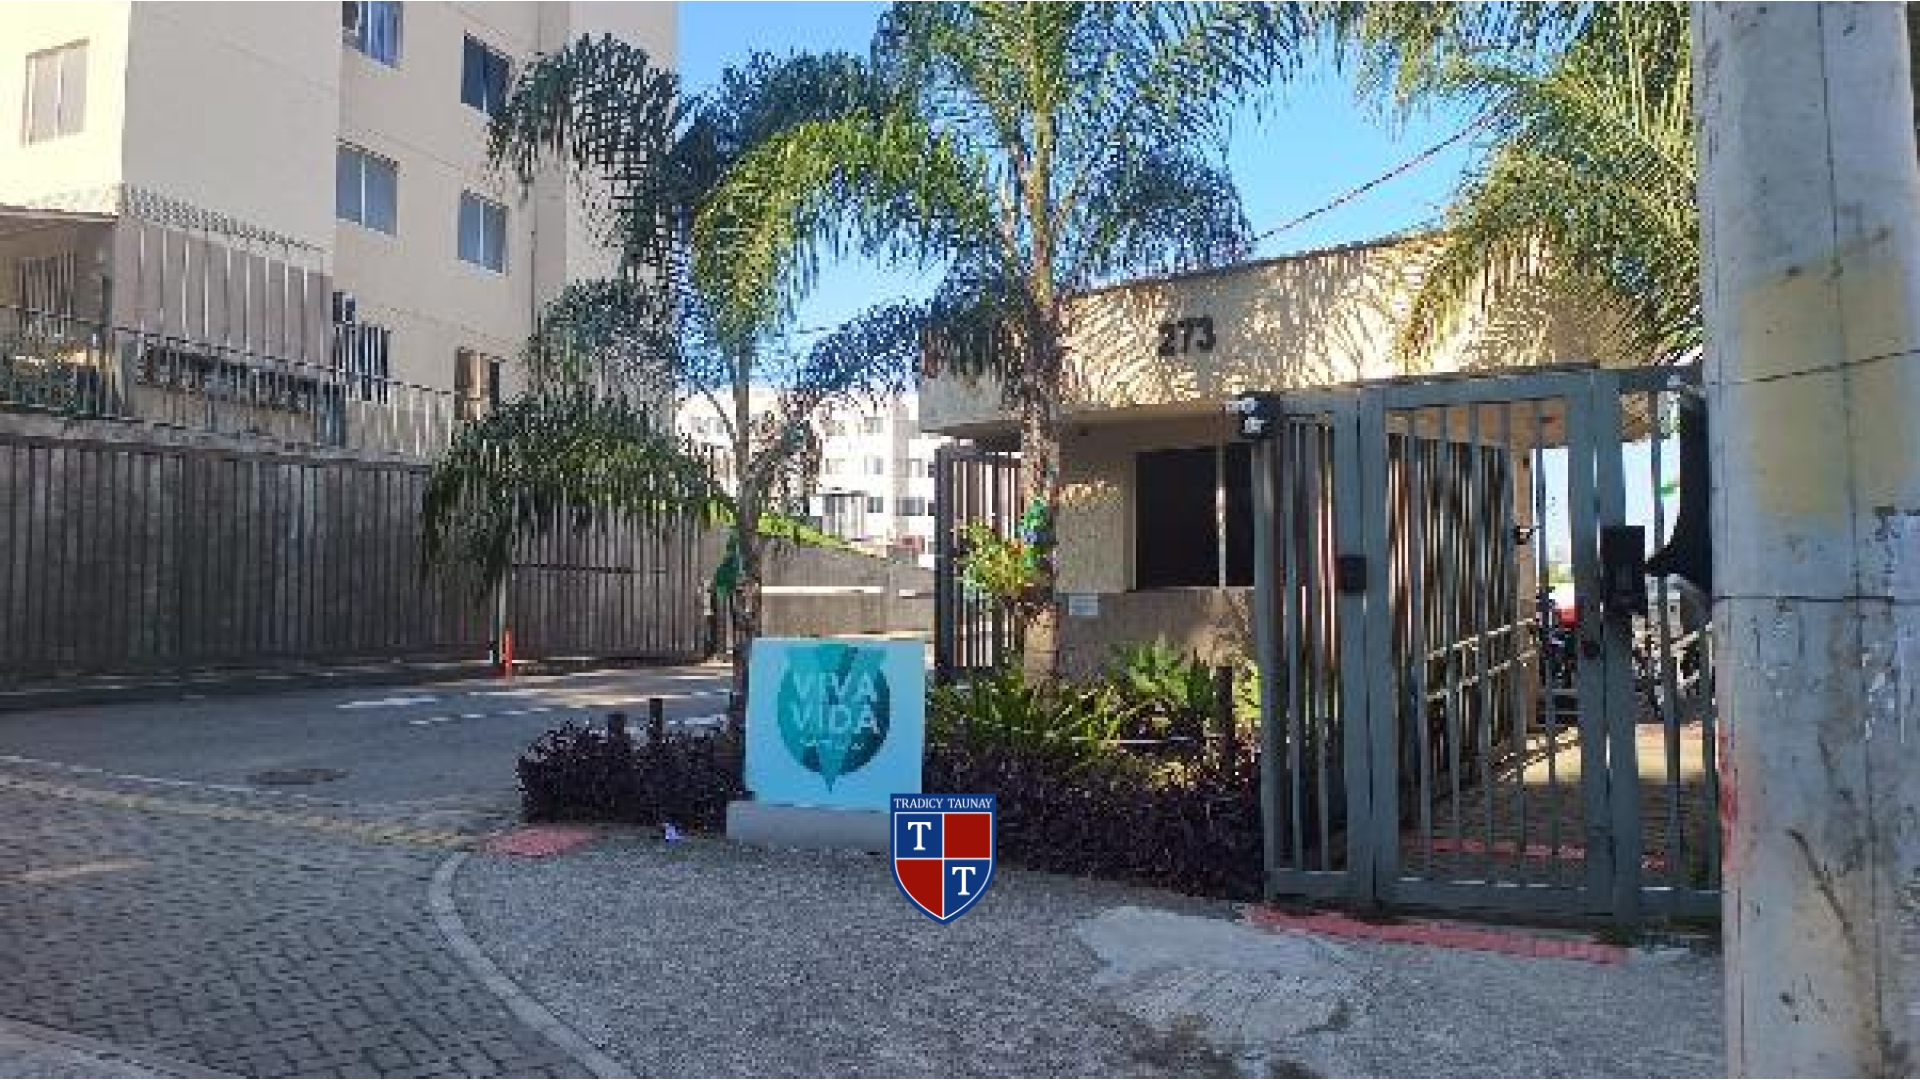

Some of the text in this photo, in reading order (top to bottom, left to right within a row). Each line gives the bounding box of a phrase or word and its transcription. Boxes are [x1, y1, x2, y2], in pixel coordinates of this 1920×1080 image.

[1158, 316, 1216, 356] 273
[793, 671, 878, 702] VIVA
[791, 703, 880, 734] VIDA
